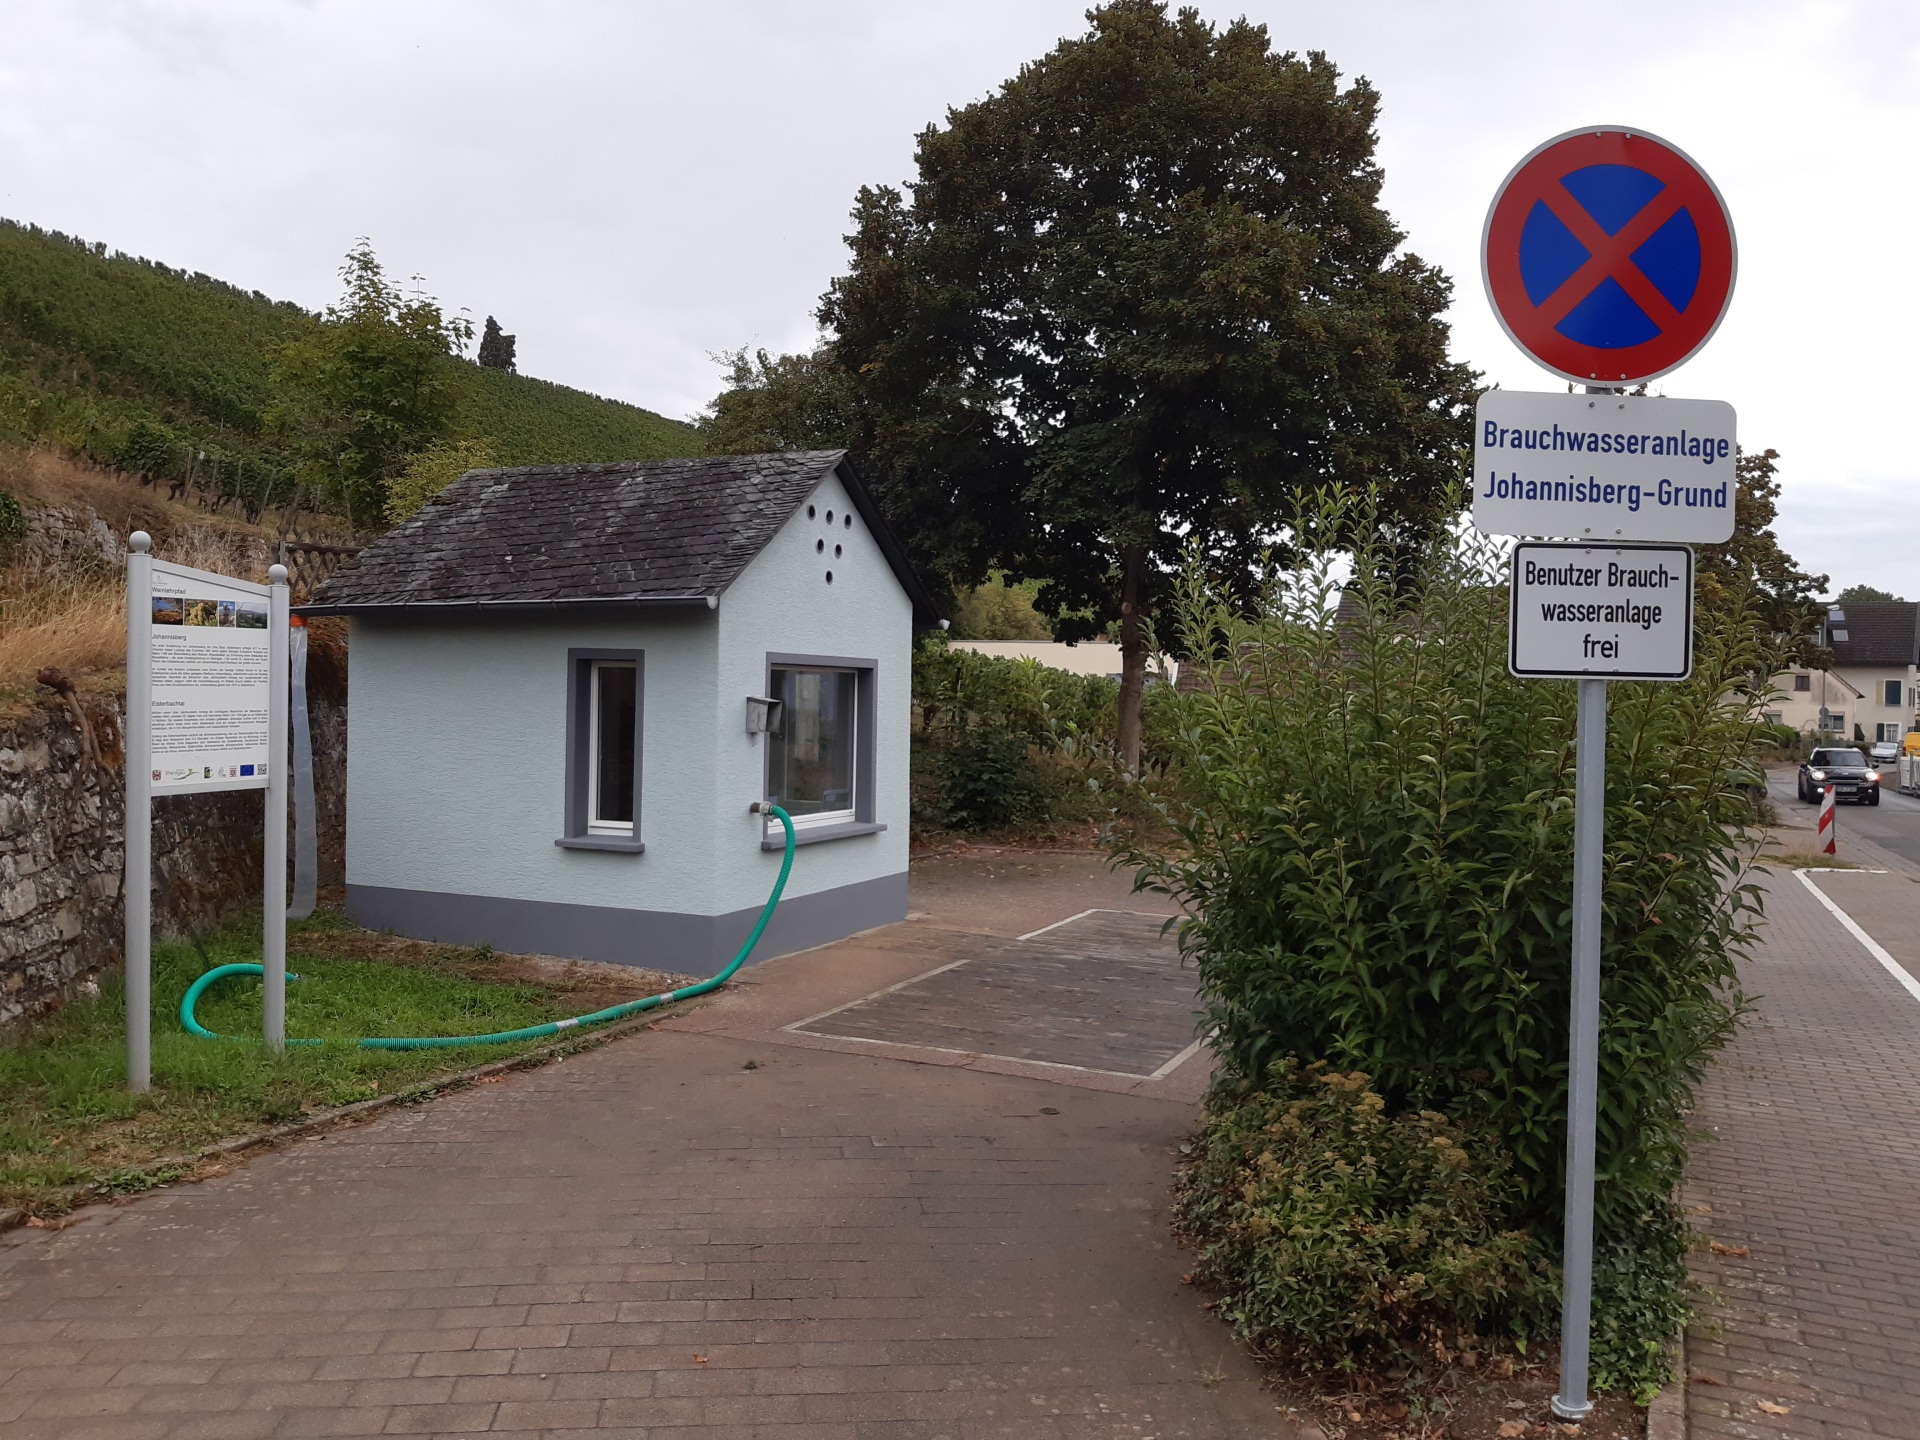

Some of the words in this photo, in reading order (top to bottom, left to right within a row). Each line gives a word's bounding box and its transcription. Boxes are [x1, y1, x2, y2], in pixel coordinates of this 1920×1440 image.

[1483, 420, 1729, 465] Brauchwasseranlage
[1483, 471, 1727, 512] Johannisberg-Grund
[1525, 560, 1602, 587] Benutzer
[1607, 562, 1679, 588] Brauch-
[1541, 598, 1662, 630] wasseranlage
[152, 633, 187, 642] Johannisberg
[1583, 633, 1619, 659] frei
